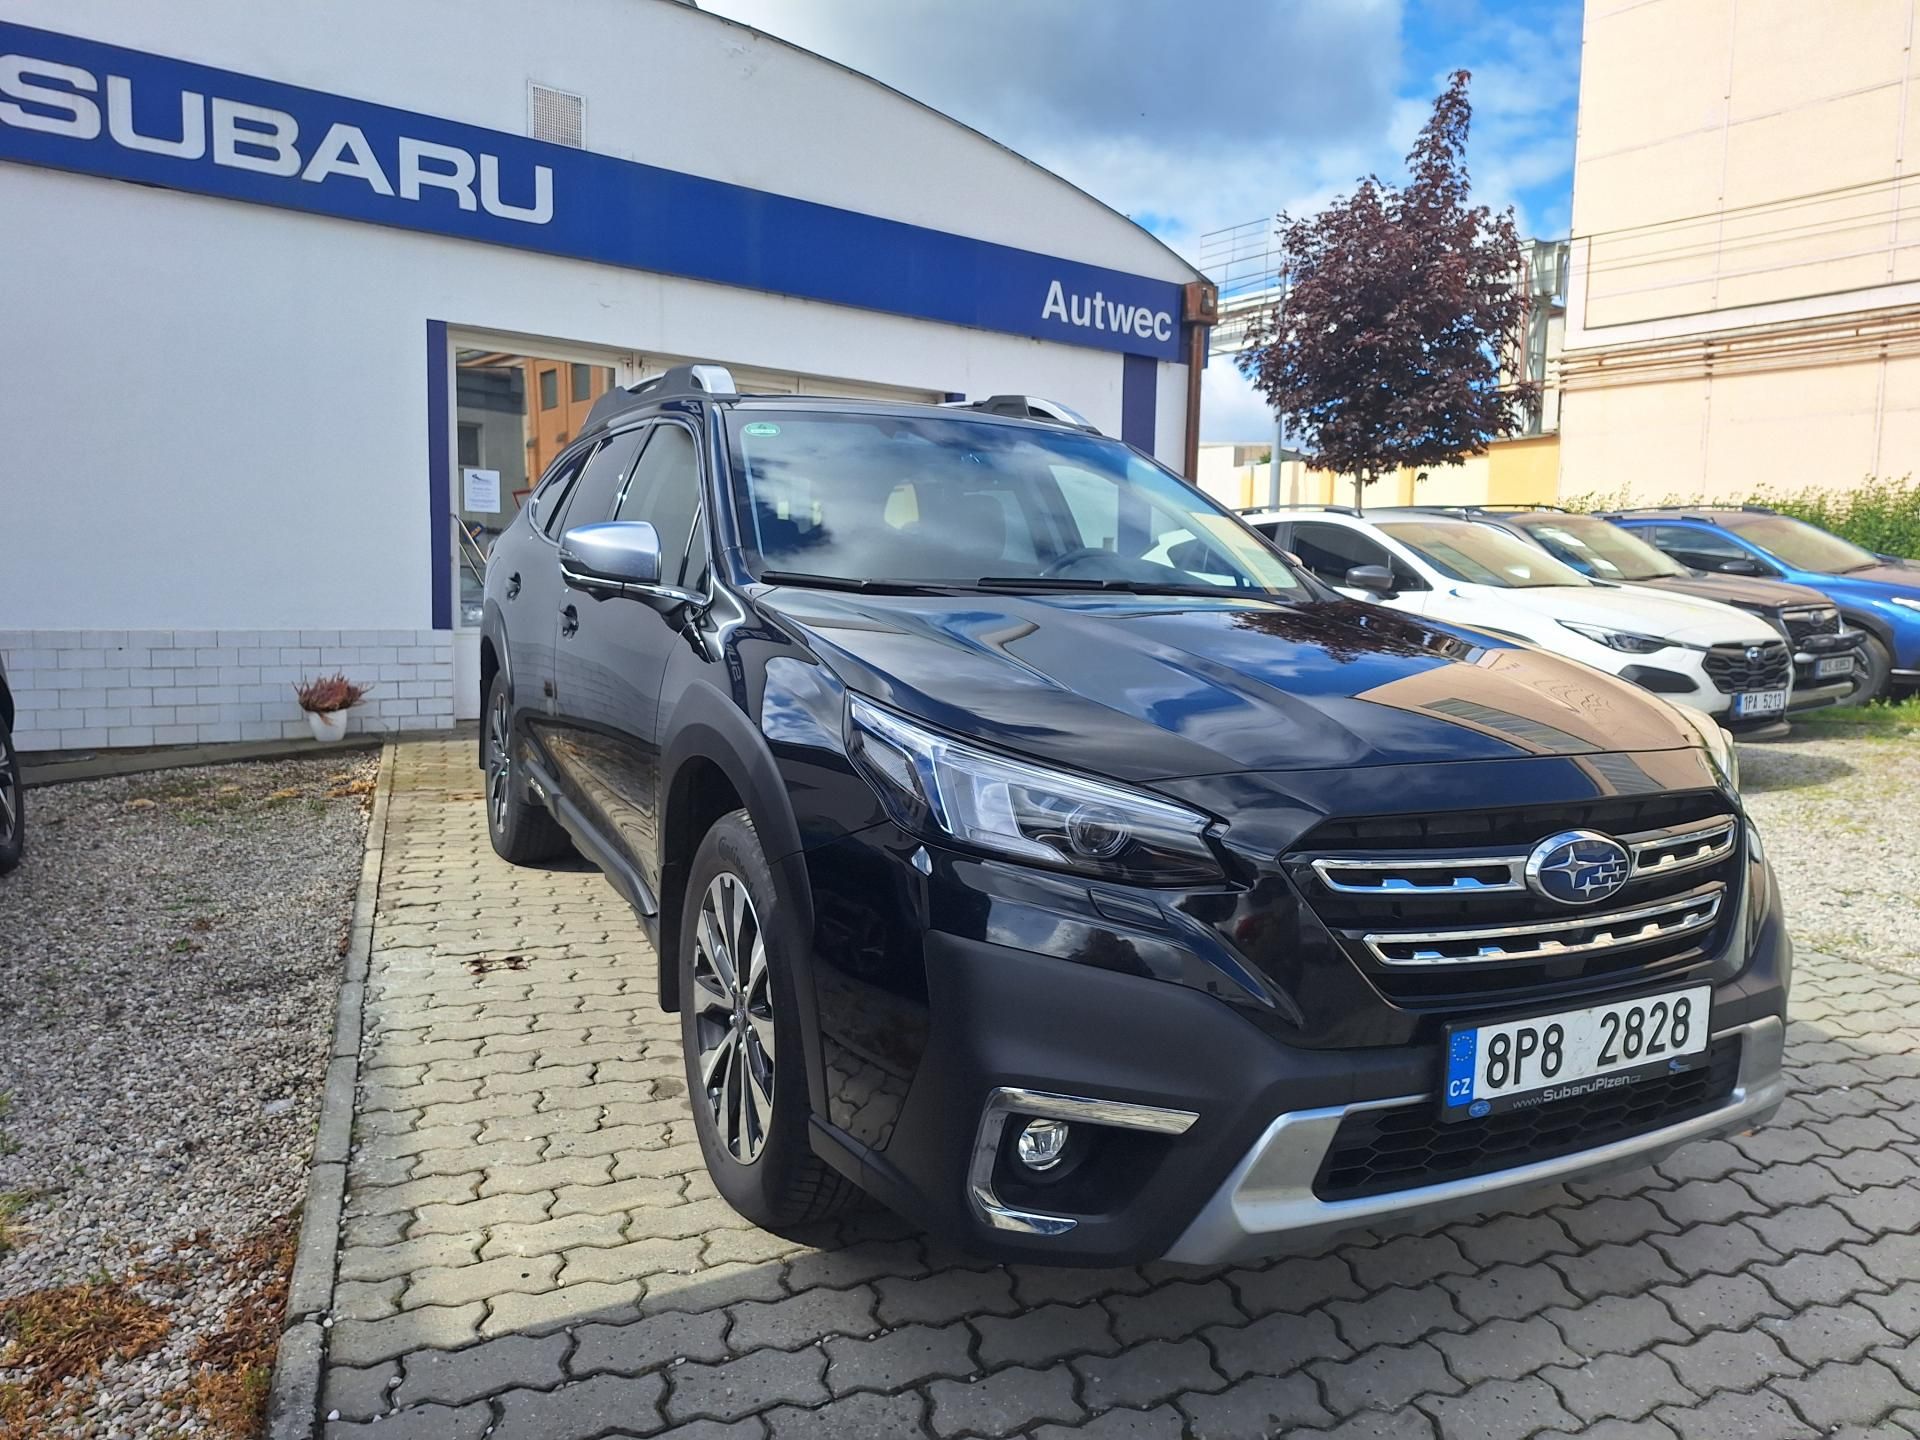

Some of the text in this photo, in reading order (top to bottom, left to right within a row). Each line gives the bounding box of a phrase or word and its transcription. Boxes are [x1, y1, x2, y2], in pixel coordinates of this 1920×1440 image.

[0, 54, 554, 225] SUBARU
[1041, 280, 1172, 342] Autwec
[1486, 997, 1691, 1089] 8P8 2828
[1450, 1078, 1471, 1097] CZ
